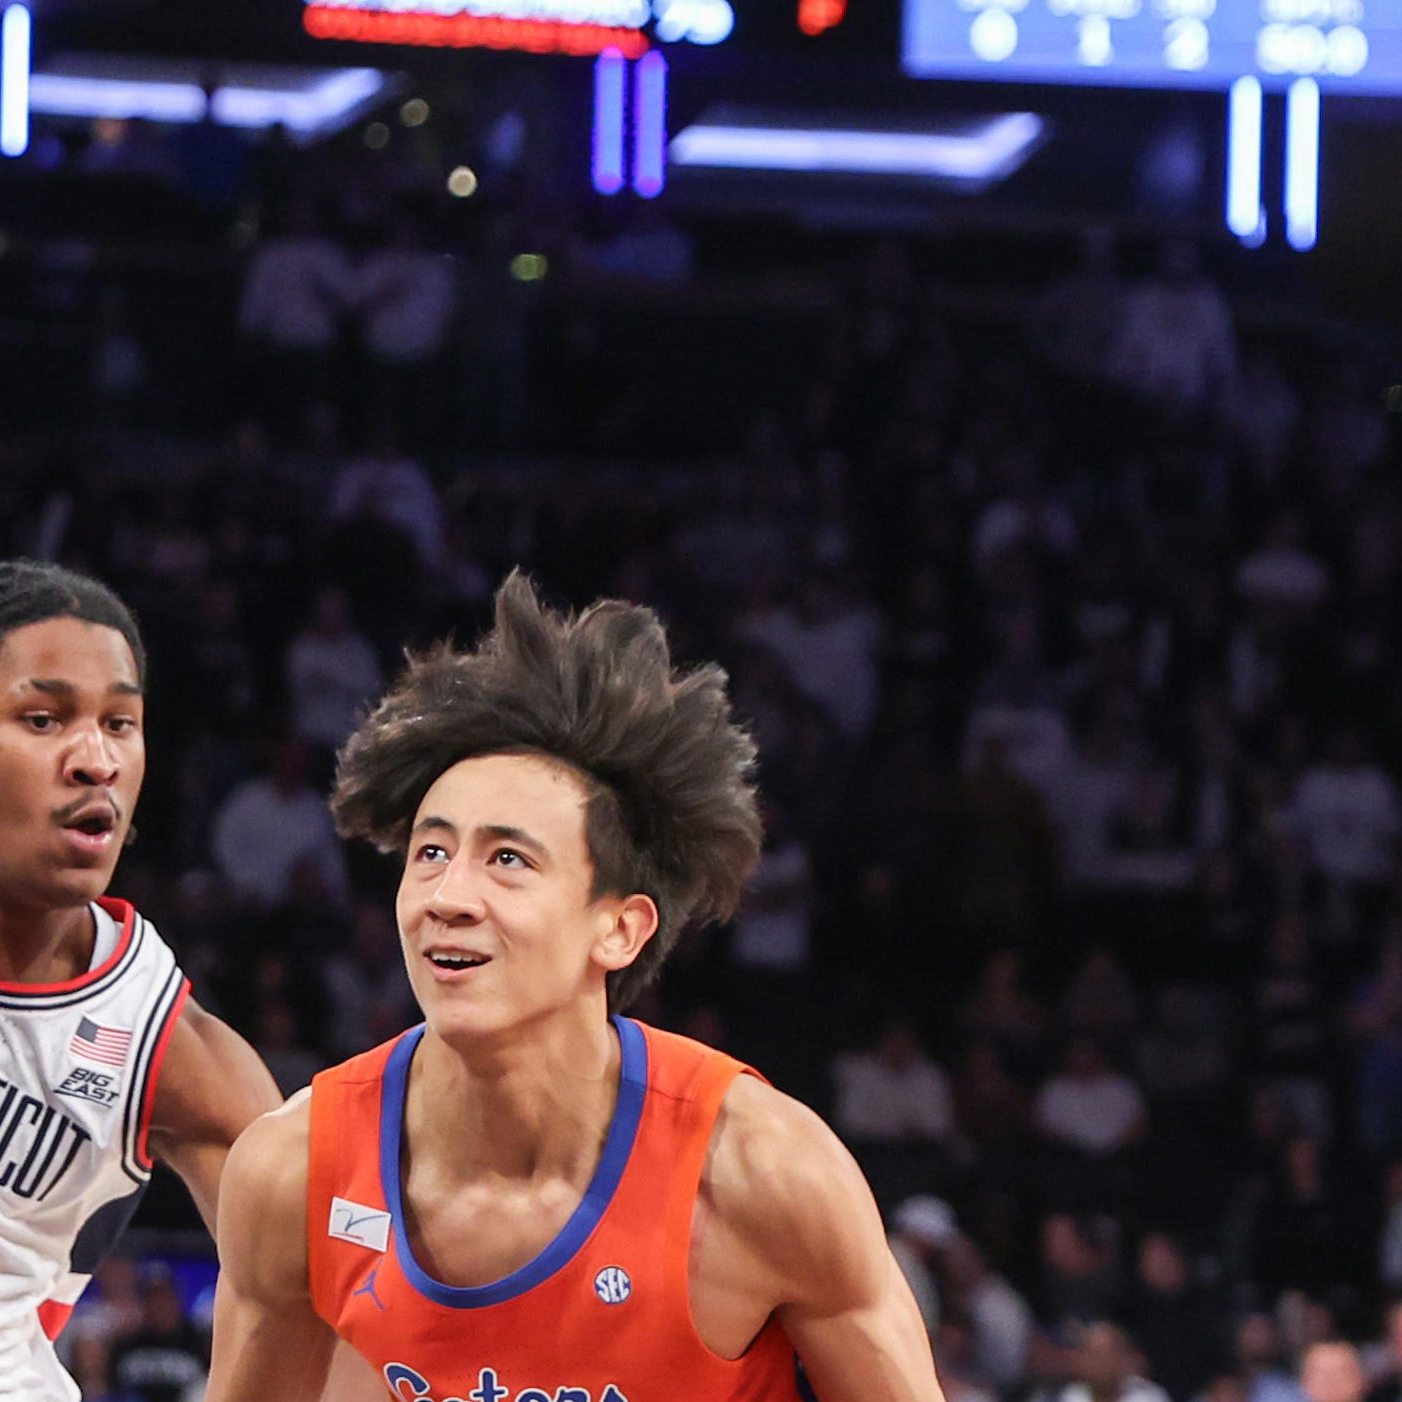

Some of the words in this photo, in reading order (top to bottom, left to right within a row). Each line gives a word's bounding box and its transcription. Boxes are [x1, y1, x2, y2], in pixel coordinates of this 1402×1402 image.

[69, 1067, 114, 1087] BIG
[59, 1079, 119, 1102] EAST
[595, 1267, 630, 1303] SEC
